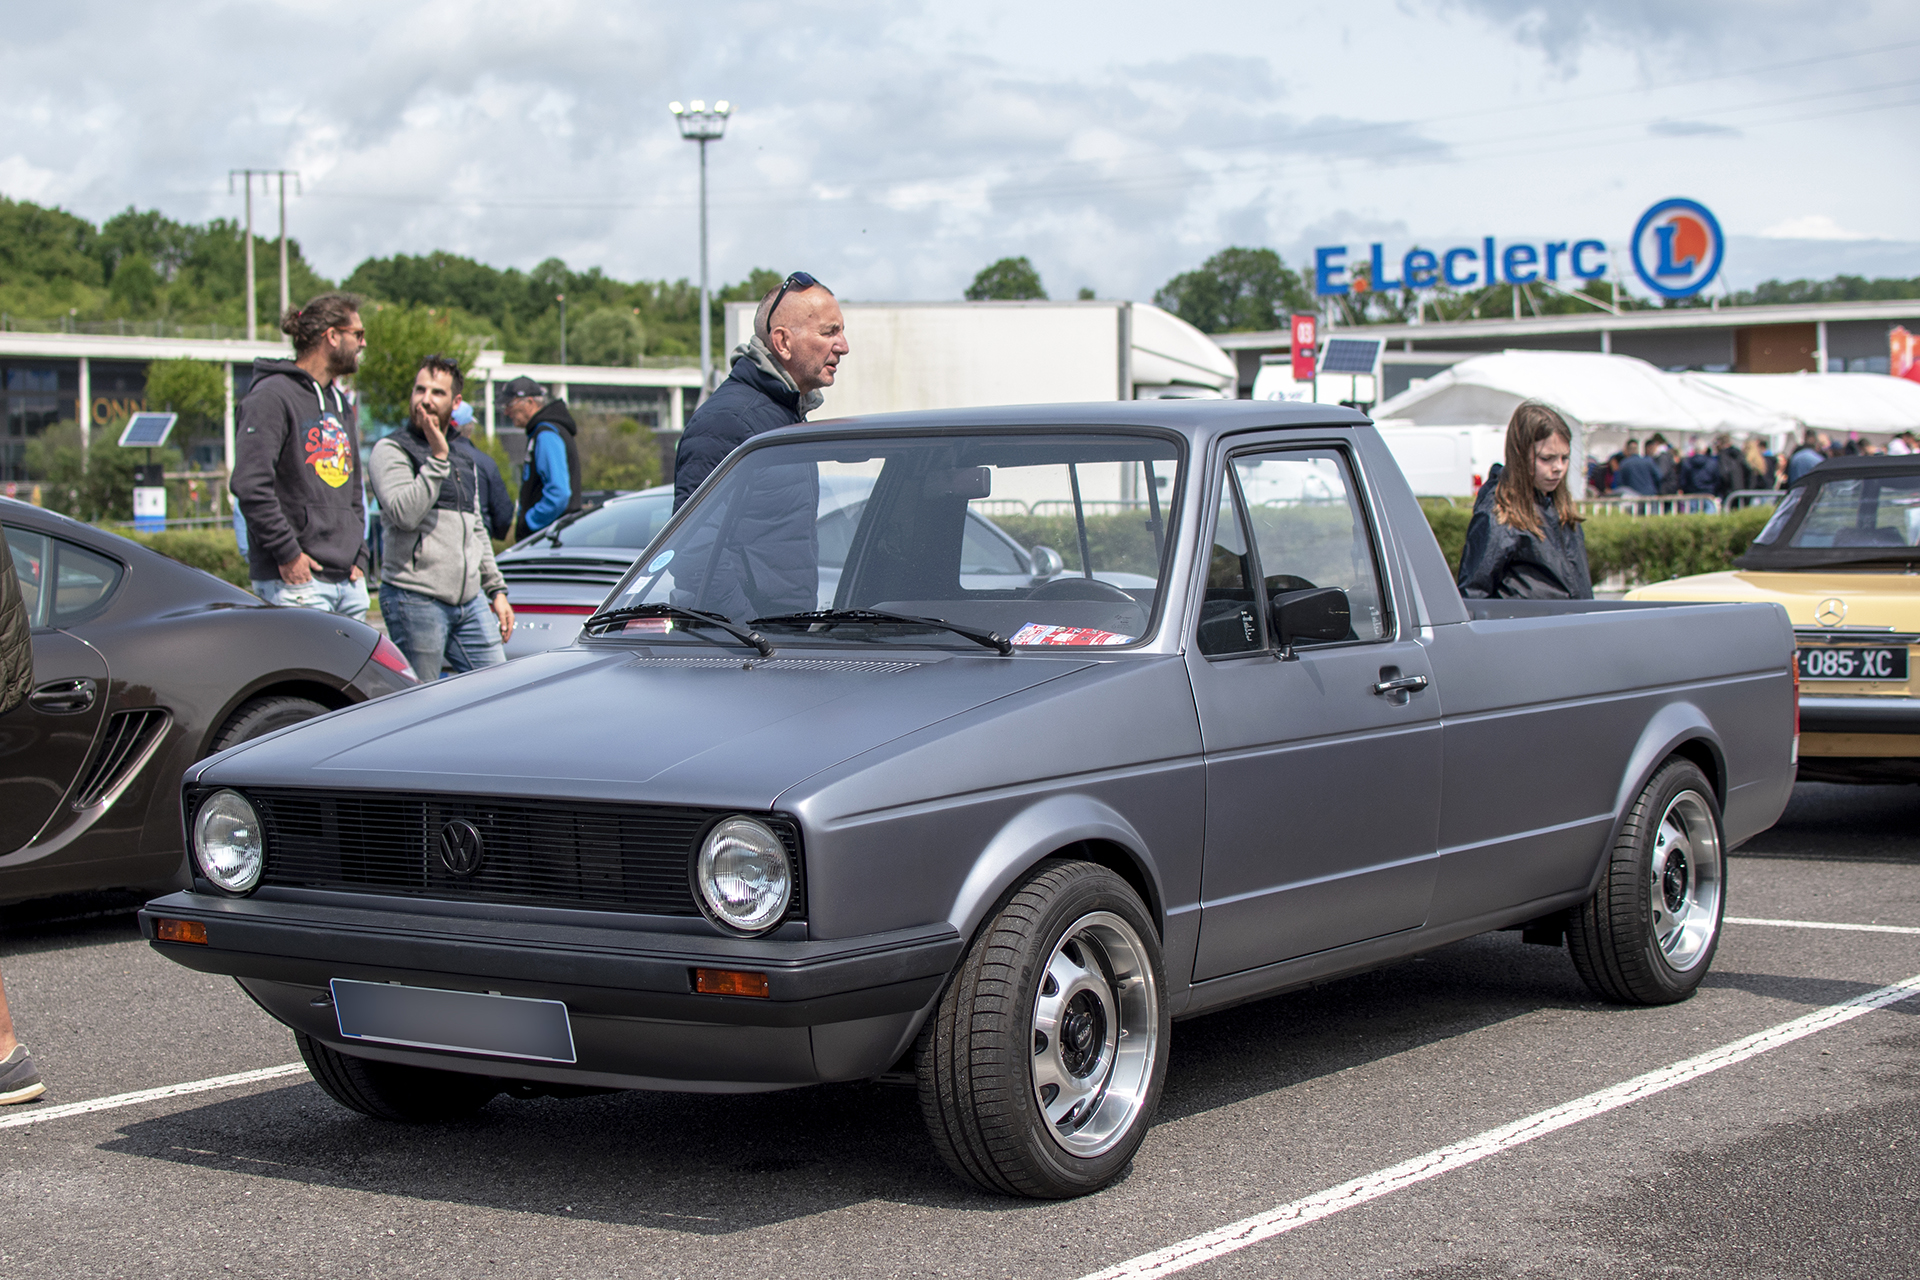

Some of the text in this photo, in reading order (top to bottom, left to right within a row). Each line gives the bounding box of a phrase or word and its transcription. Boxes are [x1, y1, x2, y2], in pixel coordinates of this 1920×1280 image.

[1655, 224, 1695, 279] L
[1795, 650, 1893, 676] -085-XC
[440, 822, 479, 873] VW
